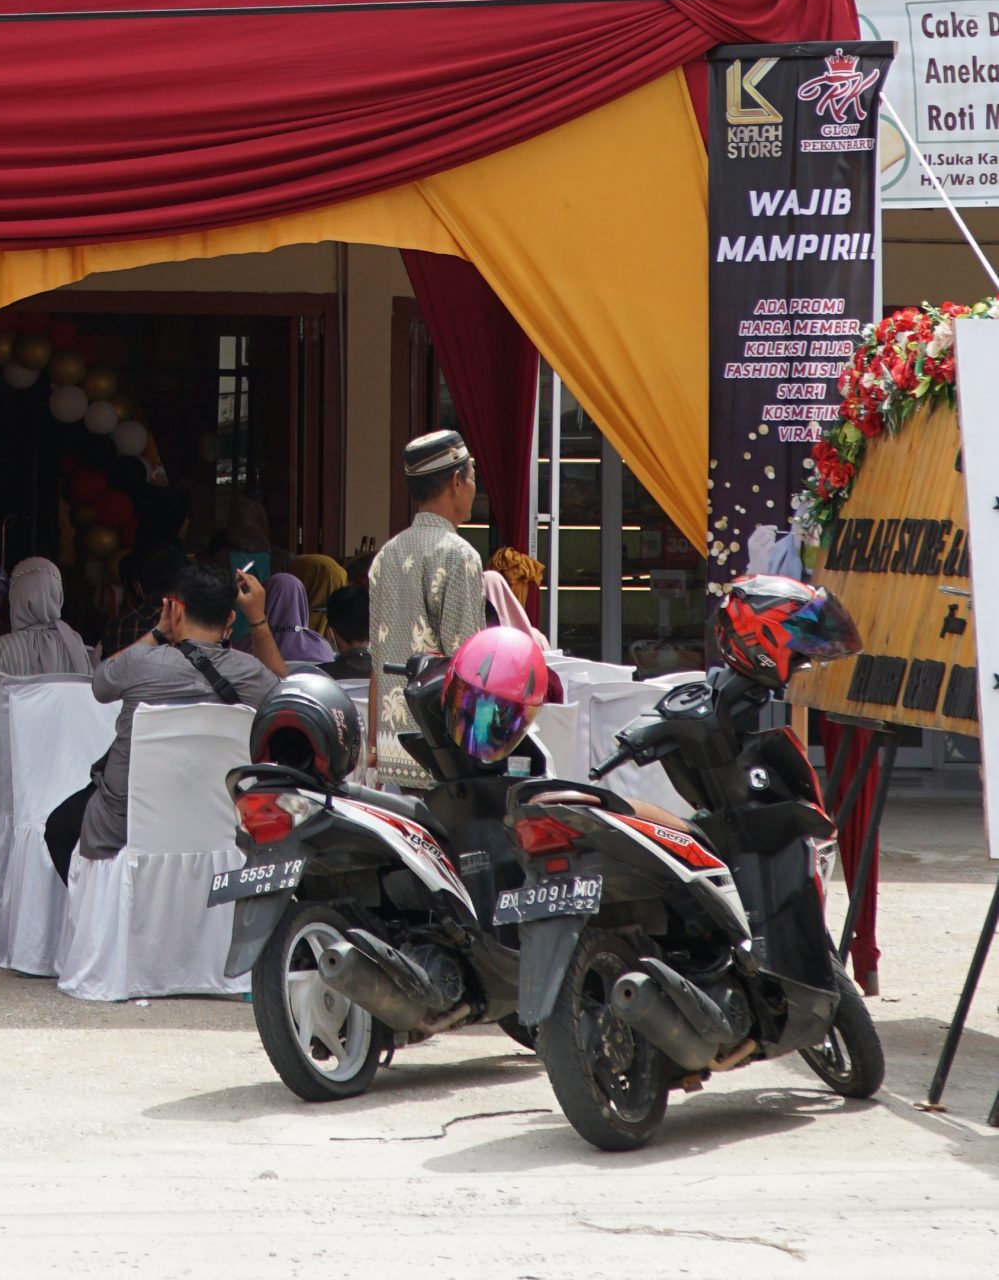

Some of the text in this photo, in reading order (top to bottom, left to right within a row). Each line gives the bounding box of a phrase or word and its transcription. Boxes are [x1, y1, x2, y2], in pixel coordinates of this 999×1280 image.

[921, 12, 979, 39] Cake
[925, 55, 999, 84] Aneka
[927, 103, 975, 131] Roti
[821, 123, 860, 137] GLOW
[727, 141, 783, 159] STORE
[801, 138, 875, 153] PEKANBARU
[749, 188, 852, 217] WAJIB
[754, 298, 845, 315] ADA PROMO
[739, 319, 860, 336] HARGA MEMBER
[744, 340, 853, 357] KOLEKSI HIJAB
[724, 362, 790, 378] FASHION
[776, 383, 827, 399] SYAR'I
[762, 404, 840, 421] KOSMETIK
[778, 425, 822, 442] VIRAL
[212, 859, 302, 891] BA 5553 YR
[526, 884, 568, 905] 3091
